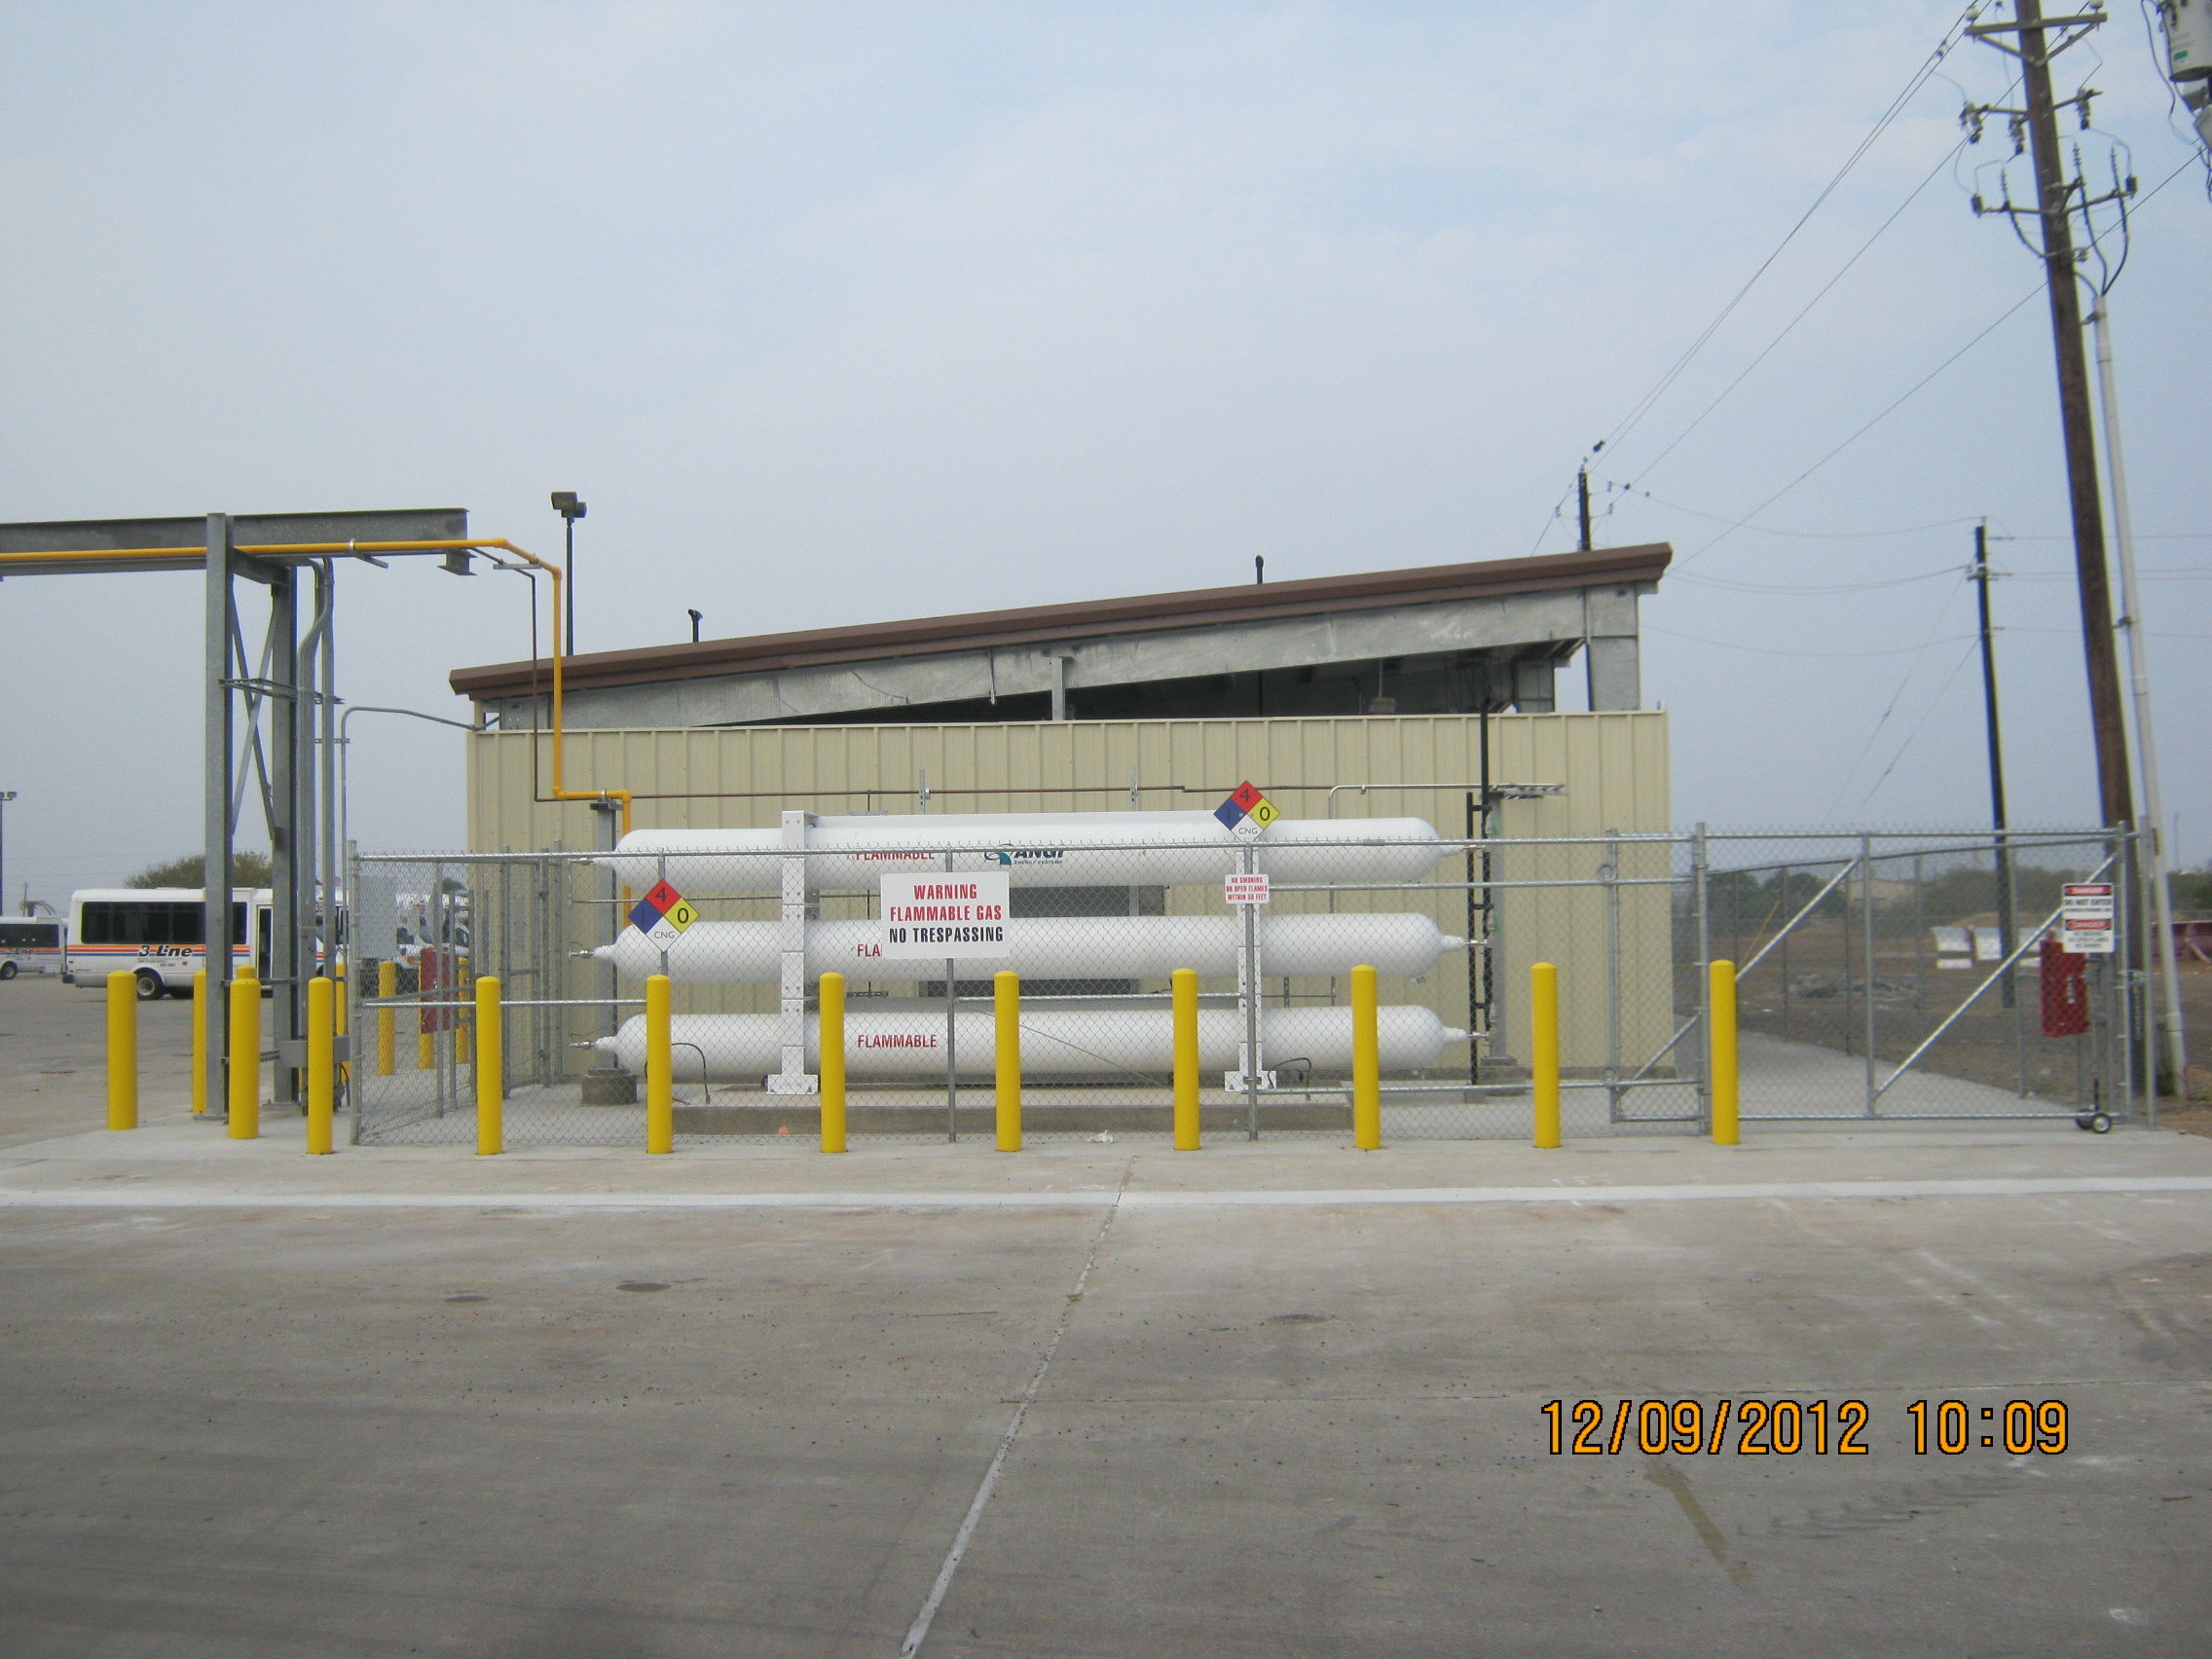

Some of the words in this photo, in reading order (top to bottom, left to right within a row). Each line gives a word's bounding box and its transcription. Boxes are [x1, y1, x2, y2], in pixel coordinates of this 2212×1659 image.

[1238, 788, 1251, 803] 4
[1259, 806, 1271, 822] 0
[1237, 827, 1258, 835] CNG
[654, 886, 668, 903] 4
[913, 883, 977, 901] WARNING
[677, 907, 689, 924] 0
[890, 904, 971, 922] FLAMMABLE
[976, 904, 1002, 921] GAS
[653, 931, 676, 940] CNG
[889, 927, 906, 943] NO
[912, 926, 1004, 943] TRESPASSING
[857, 1034, 938, 1049] FLAMMABLE
